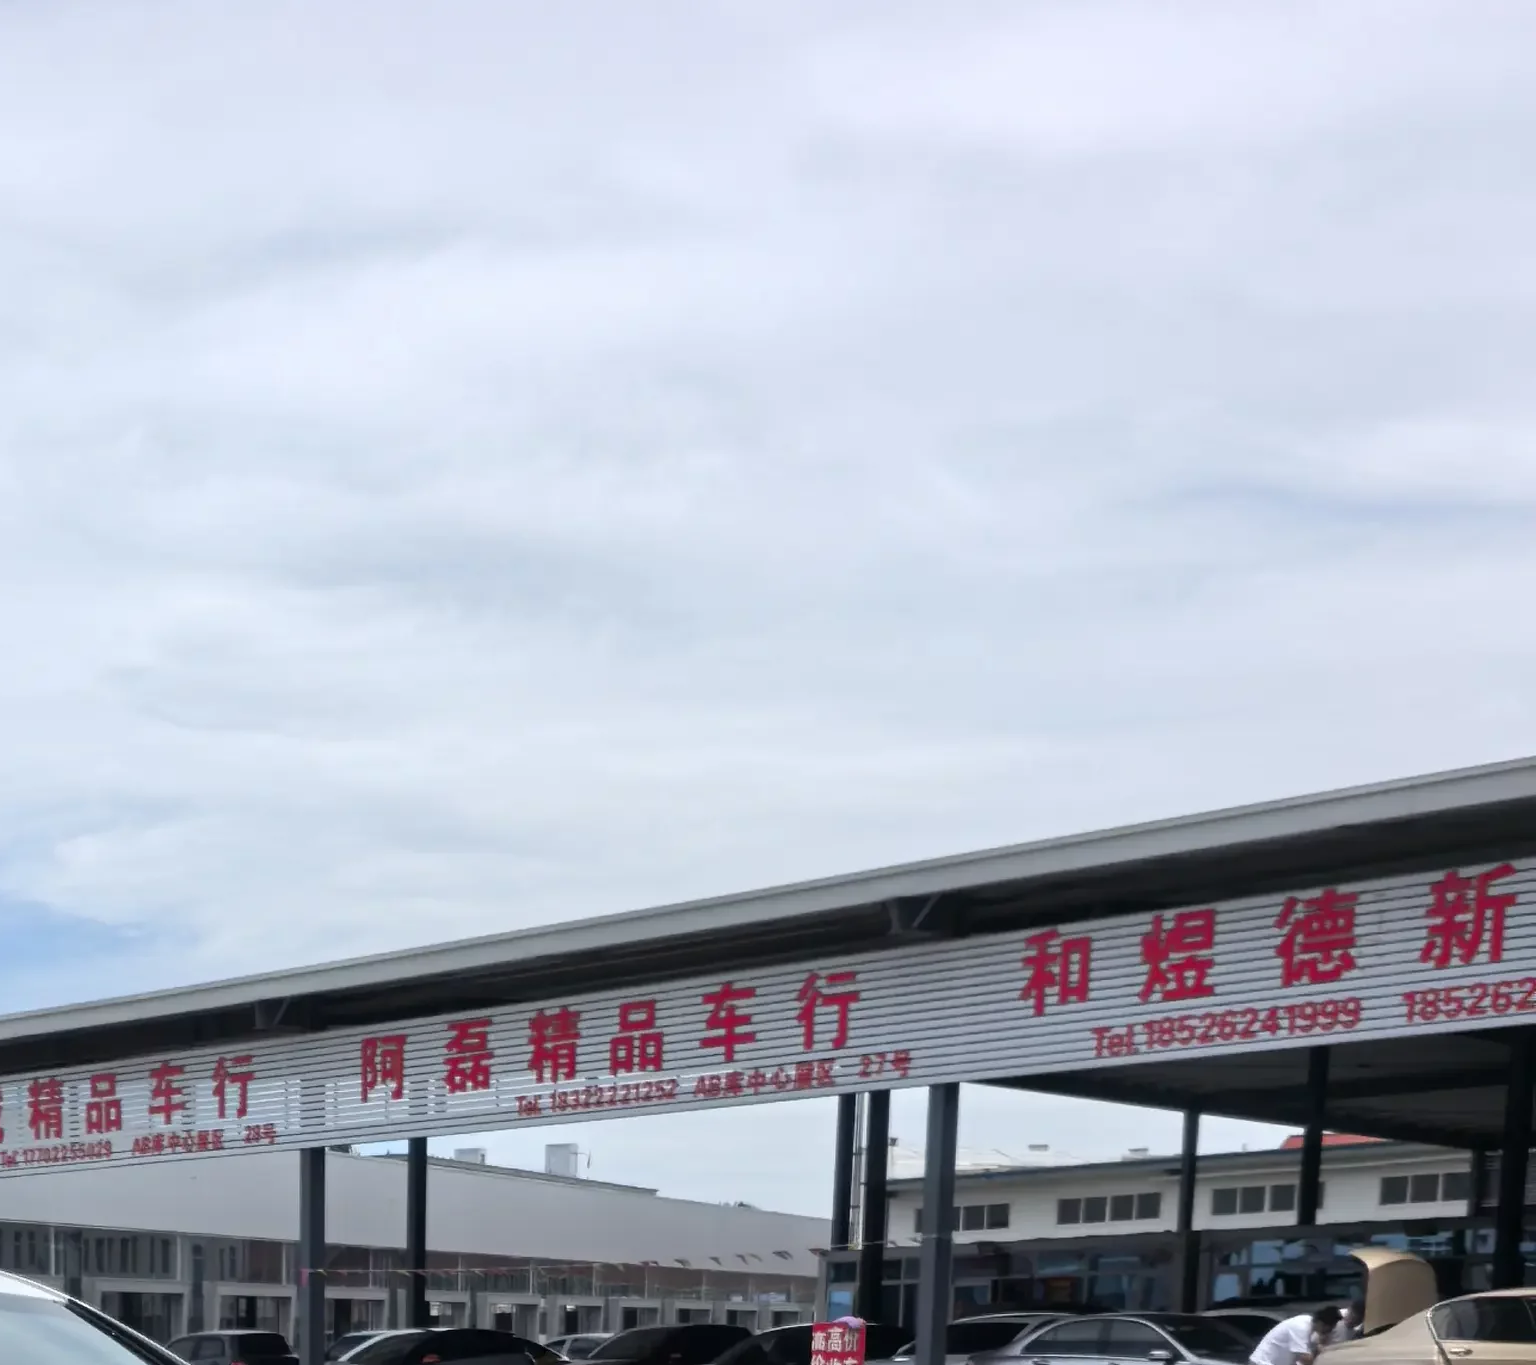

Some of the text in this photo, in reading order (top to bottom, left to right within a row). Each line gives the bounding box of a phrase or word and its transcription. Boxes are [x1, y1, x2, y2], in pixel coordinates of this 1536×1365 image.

[1020, 863, 1517, 1017] 和煜德新
[360, 971, 861, 1102] 阿磊精品车行
